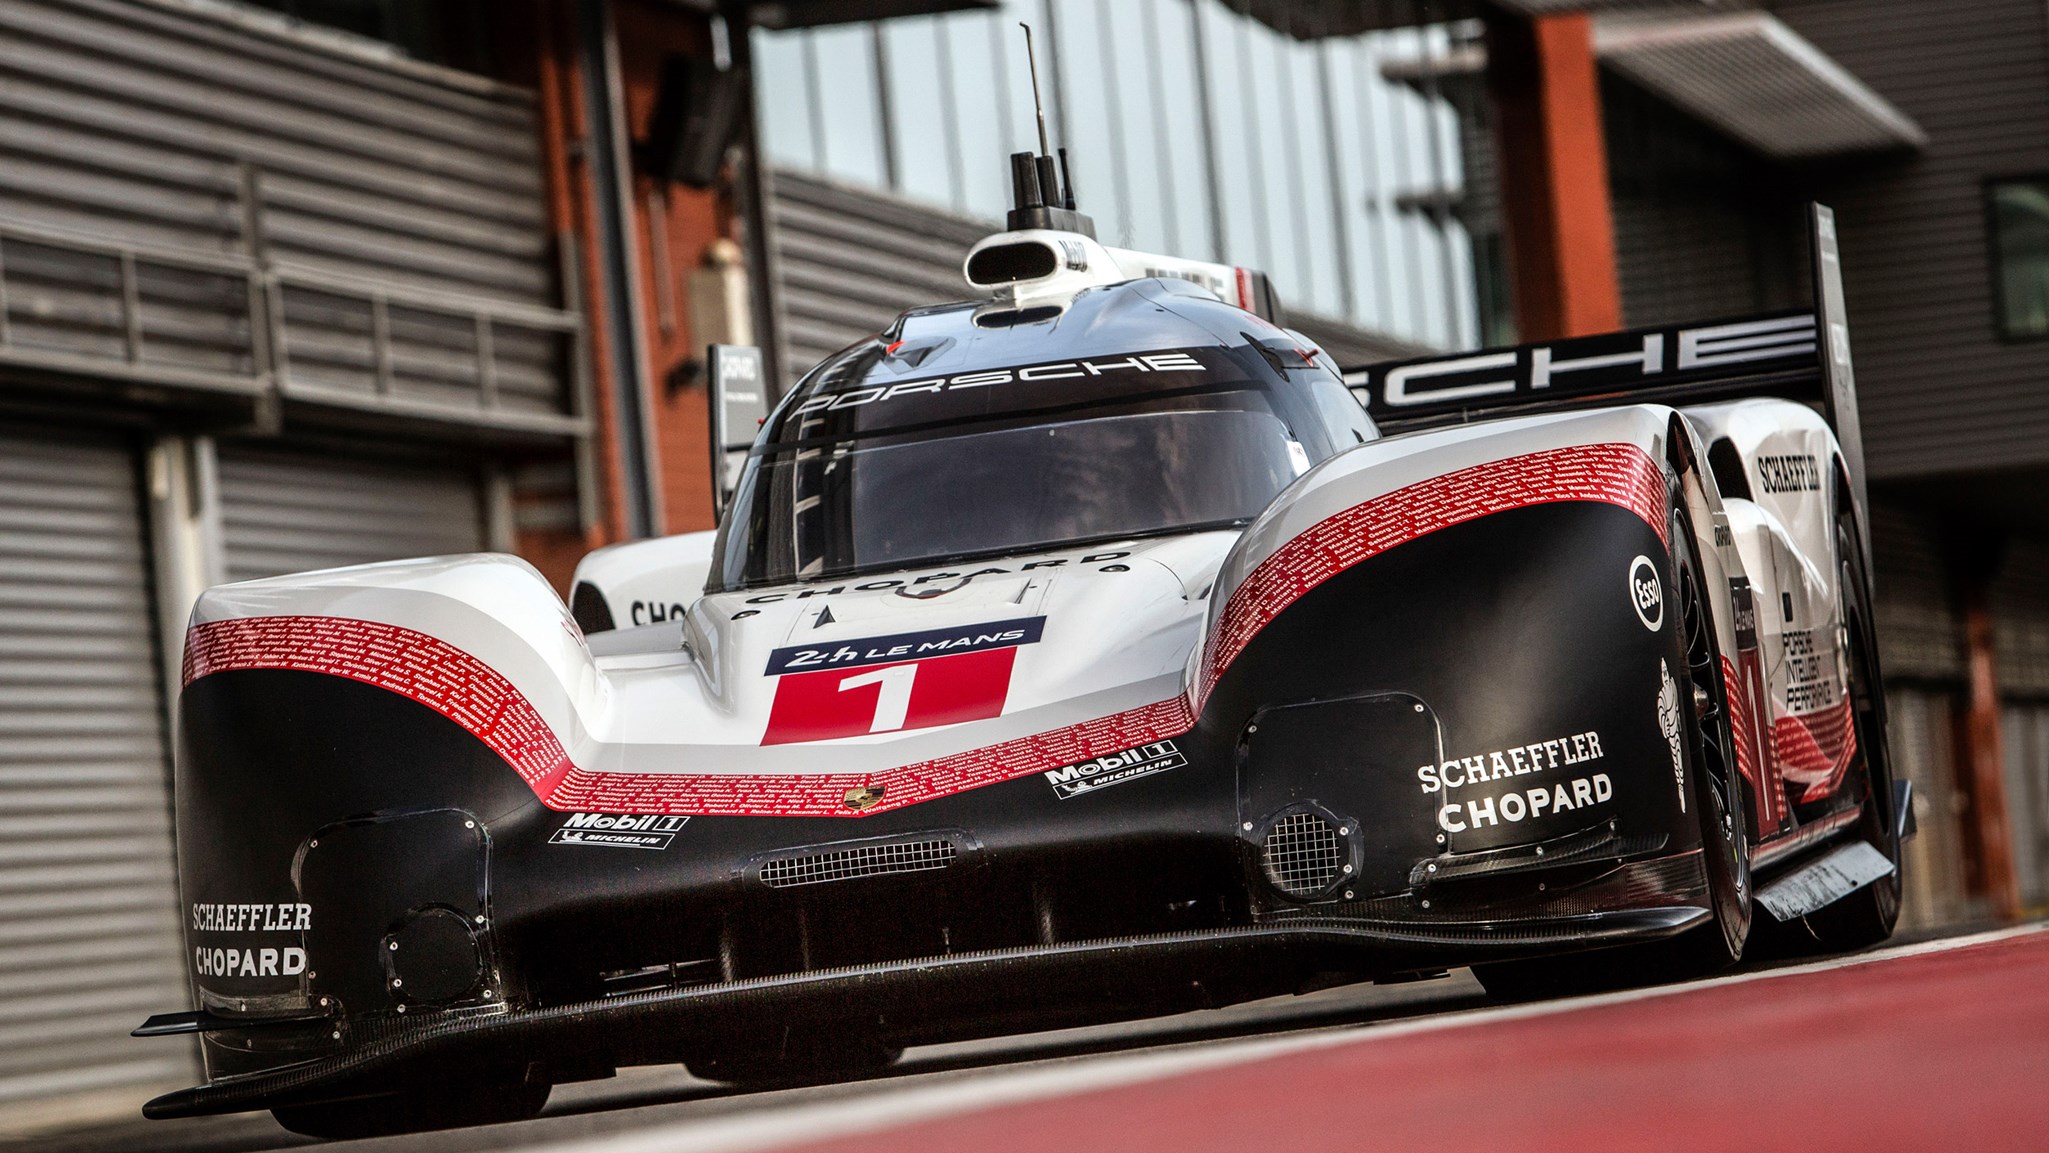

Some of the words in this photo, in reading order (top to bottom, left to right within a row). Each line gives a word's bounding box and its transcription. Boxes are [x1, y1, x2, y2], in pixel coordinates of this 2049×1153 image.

[1343, 314, 1816, 408] CHE
[786, 353, 1207, 423] PORSCHE
[746, 551, 1131, 603] CHOPARD
[1636, 578, 1660, 610] Esso
[865, 644, 912, 658] LE
[917, 629, 1025, 653] MANS
[838, 663, 919, 733] 1
[1044, 749, 1142, 785] Mobil
[1094, 759, 1172, 785] MICHELIN
[1417, 731, 1604, 794] SCHAEFFLER
[1438, 773, 1613, 833] CHOPARD
[563, 813, 658, 830] Mobil
[585, 834, 661, 844] MICHELIN
[193, 903, 312, 931] SCHAEFFLER
[196, 946, 307, 976] CHOPARD
